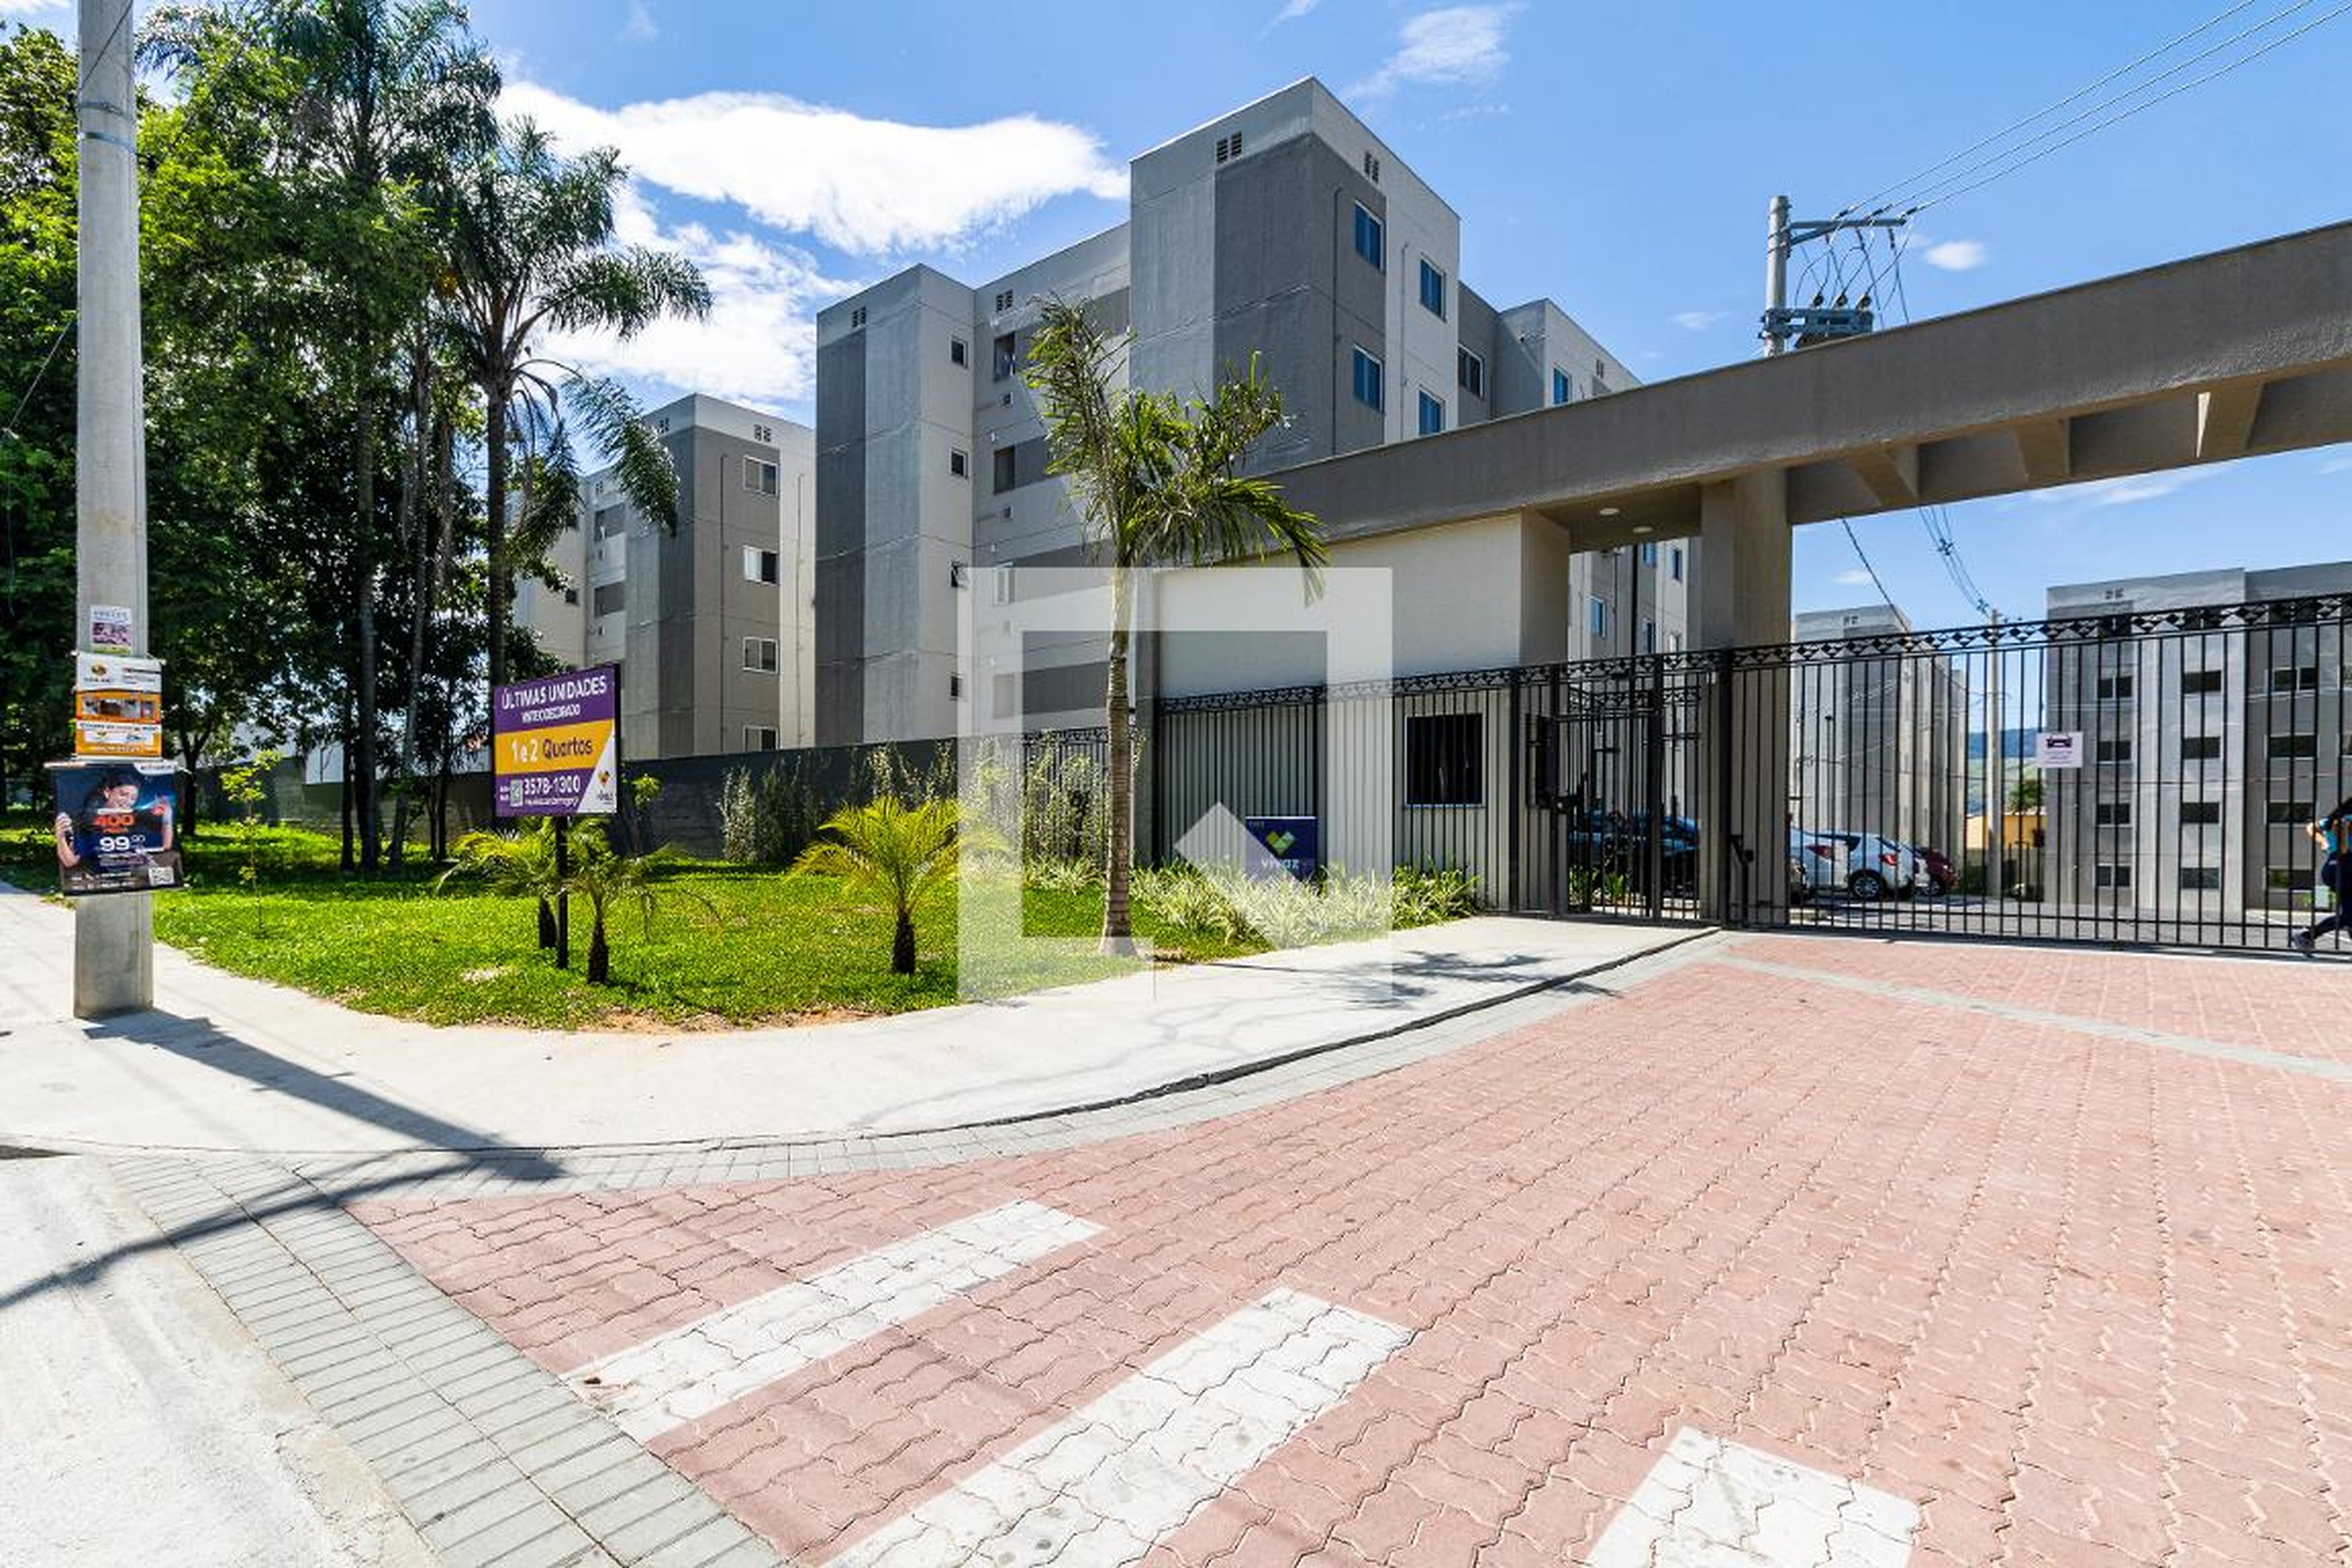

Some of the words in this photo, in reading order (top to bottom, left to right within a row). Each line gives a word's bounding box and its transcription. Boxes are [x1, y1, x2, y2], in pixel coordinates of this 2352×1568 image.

[548, 675, 607, 701] UNIDADES
[511, 738, 519, 763] 1
[521, 746, 528, 763] e
[530, 738, 538, 762] 2
[543, 736, 594, 760] Quartos
